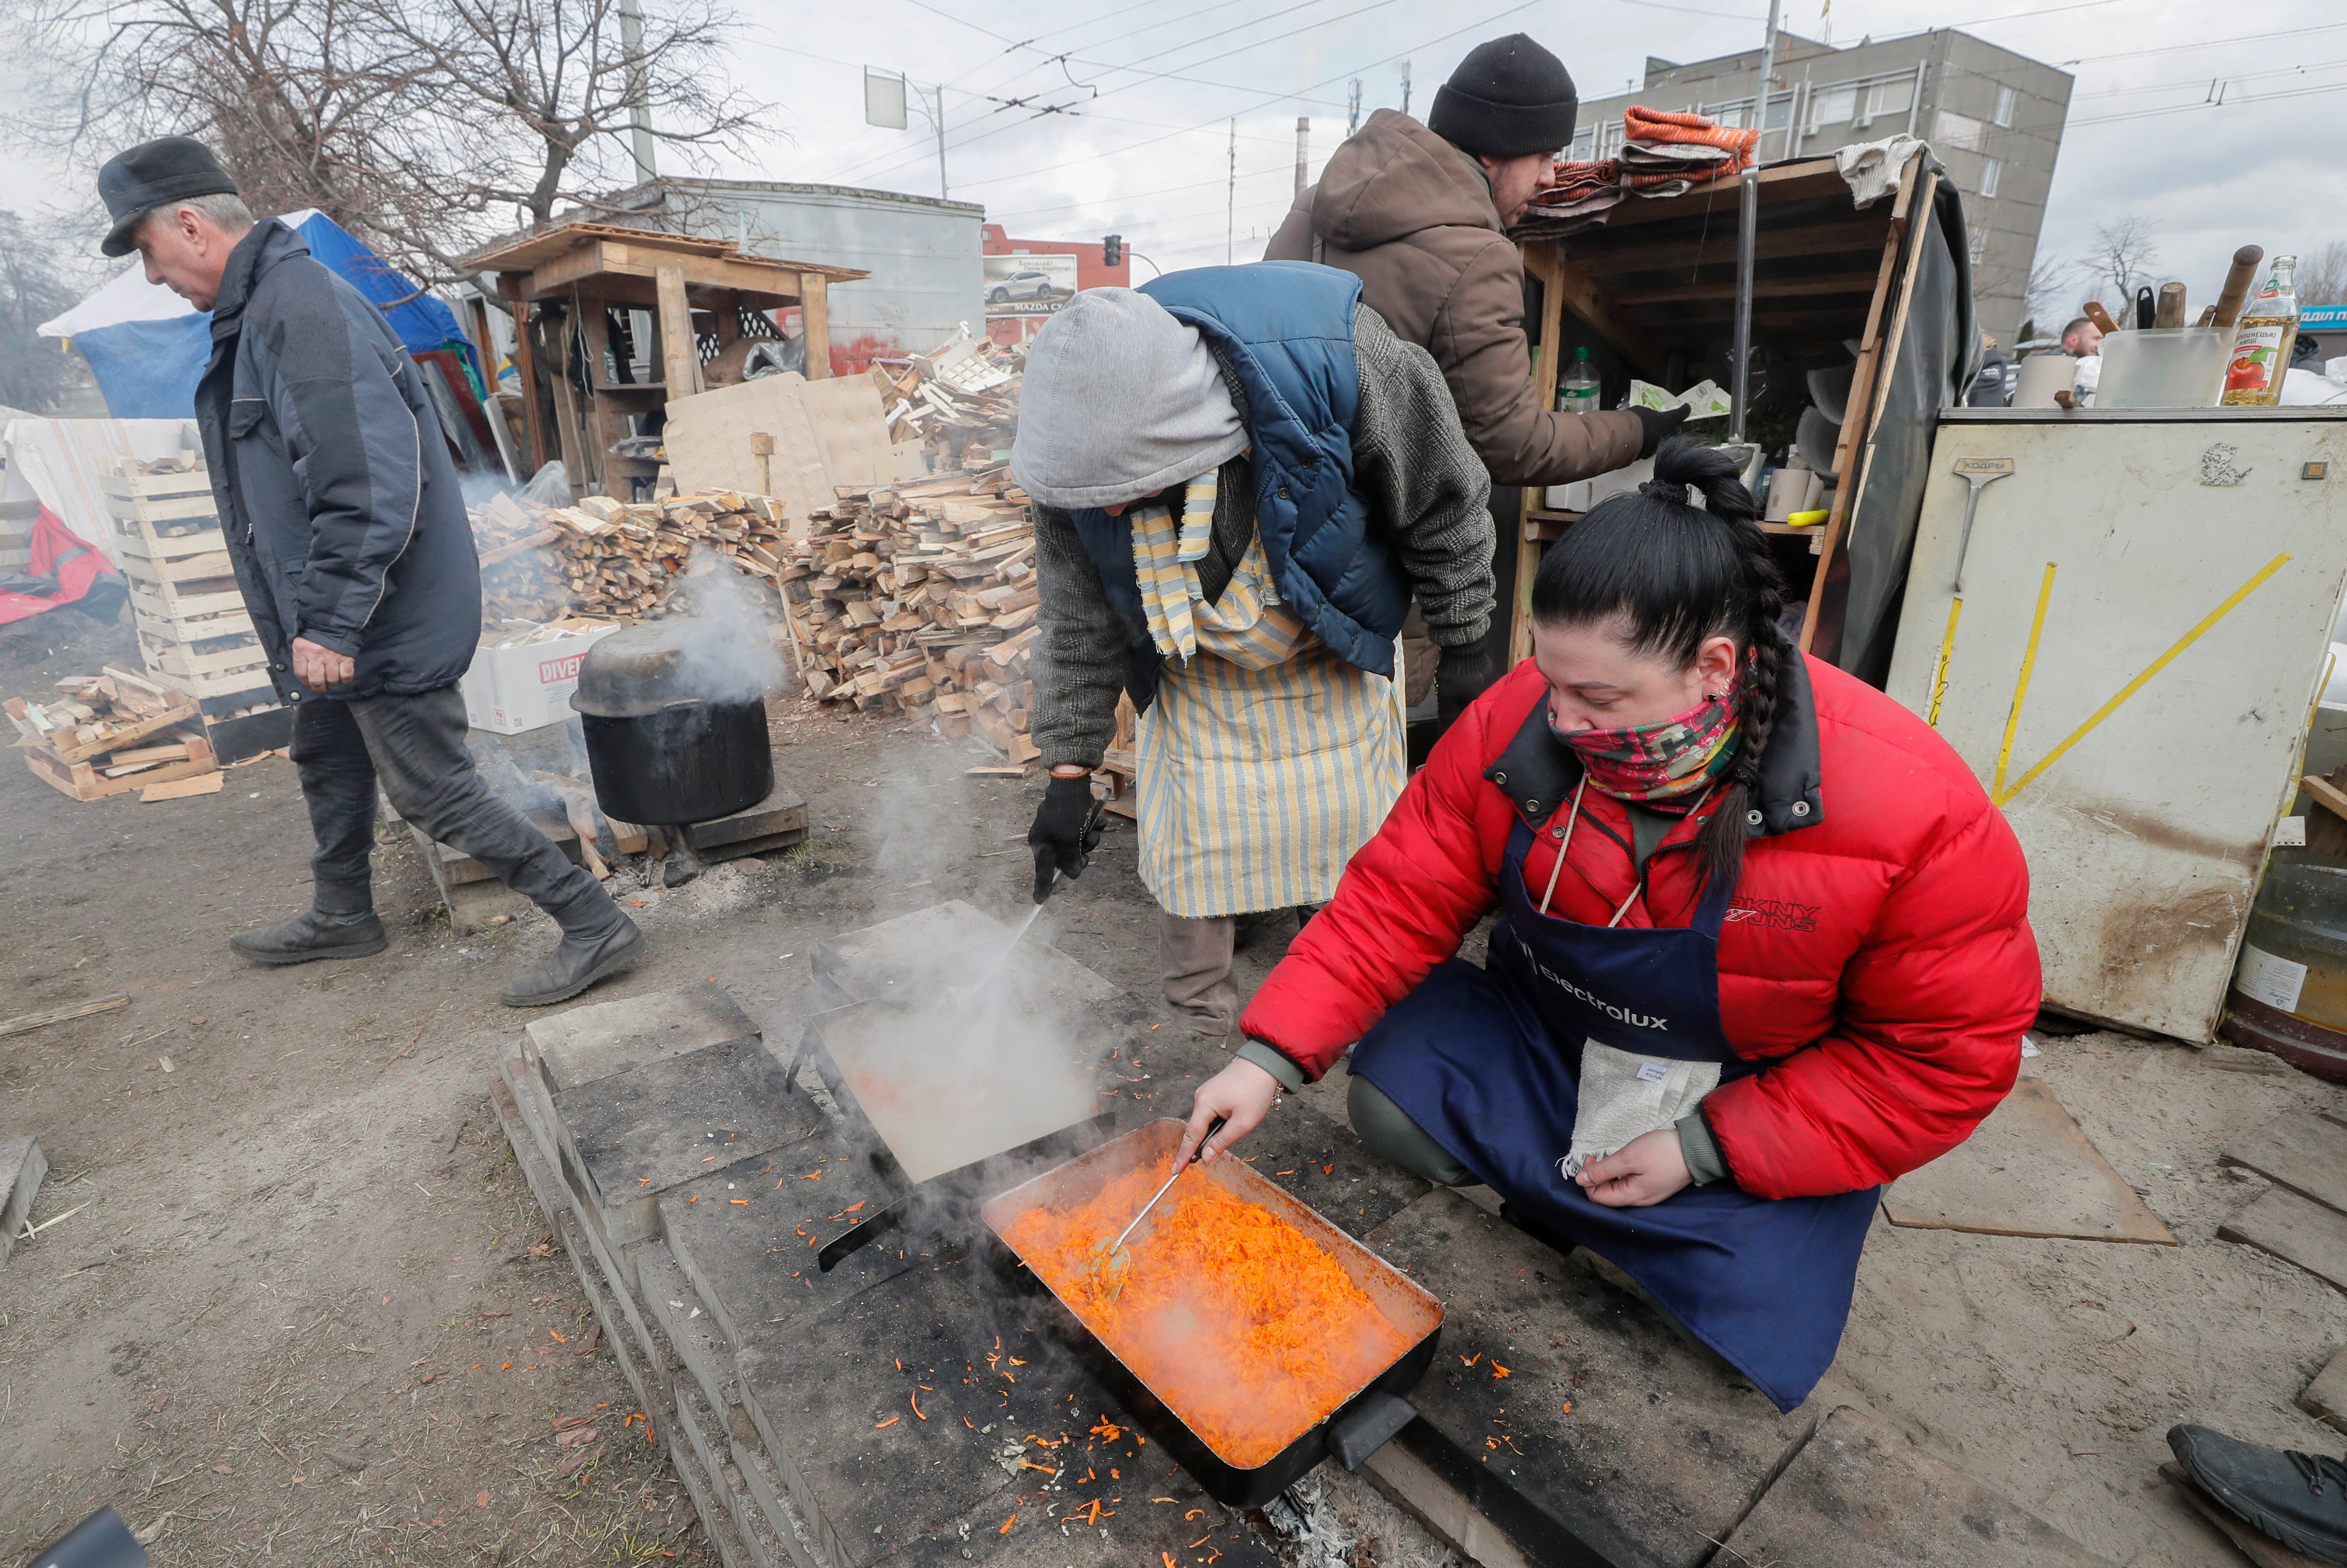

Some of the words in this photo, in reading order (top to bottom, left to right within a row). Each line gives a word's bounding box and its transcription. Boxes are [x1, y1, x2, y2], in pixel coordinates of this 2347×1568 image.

[1728, 896, 1821, 918] DKNY
[1747, 913, 1816, 932] JNS
[1540, 964, 1668, 1031] Electrolux
